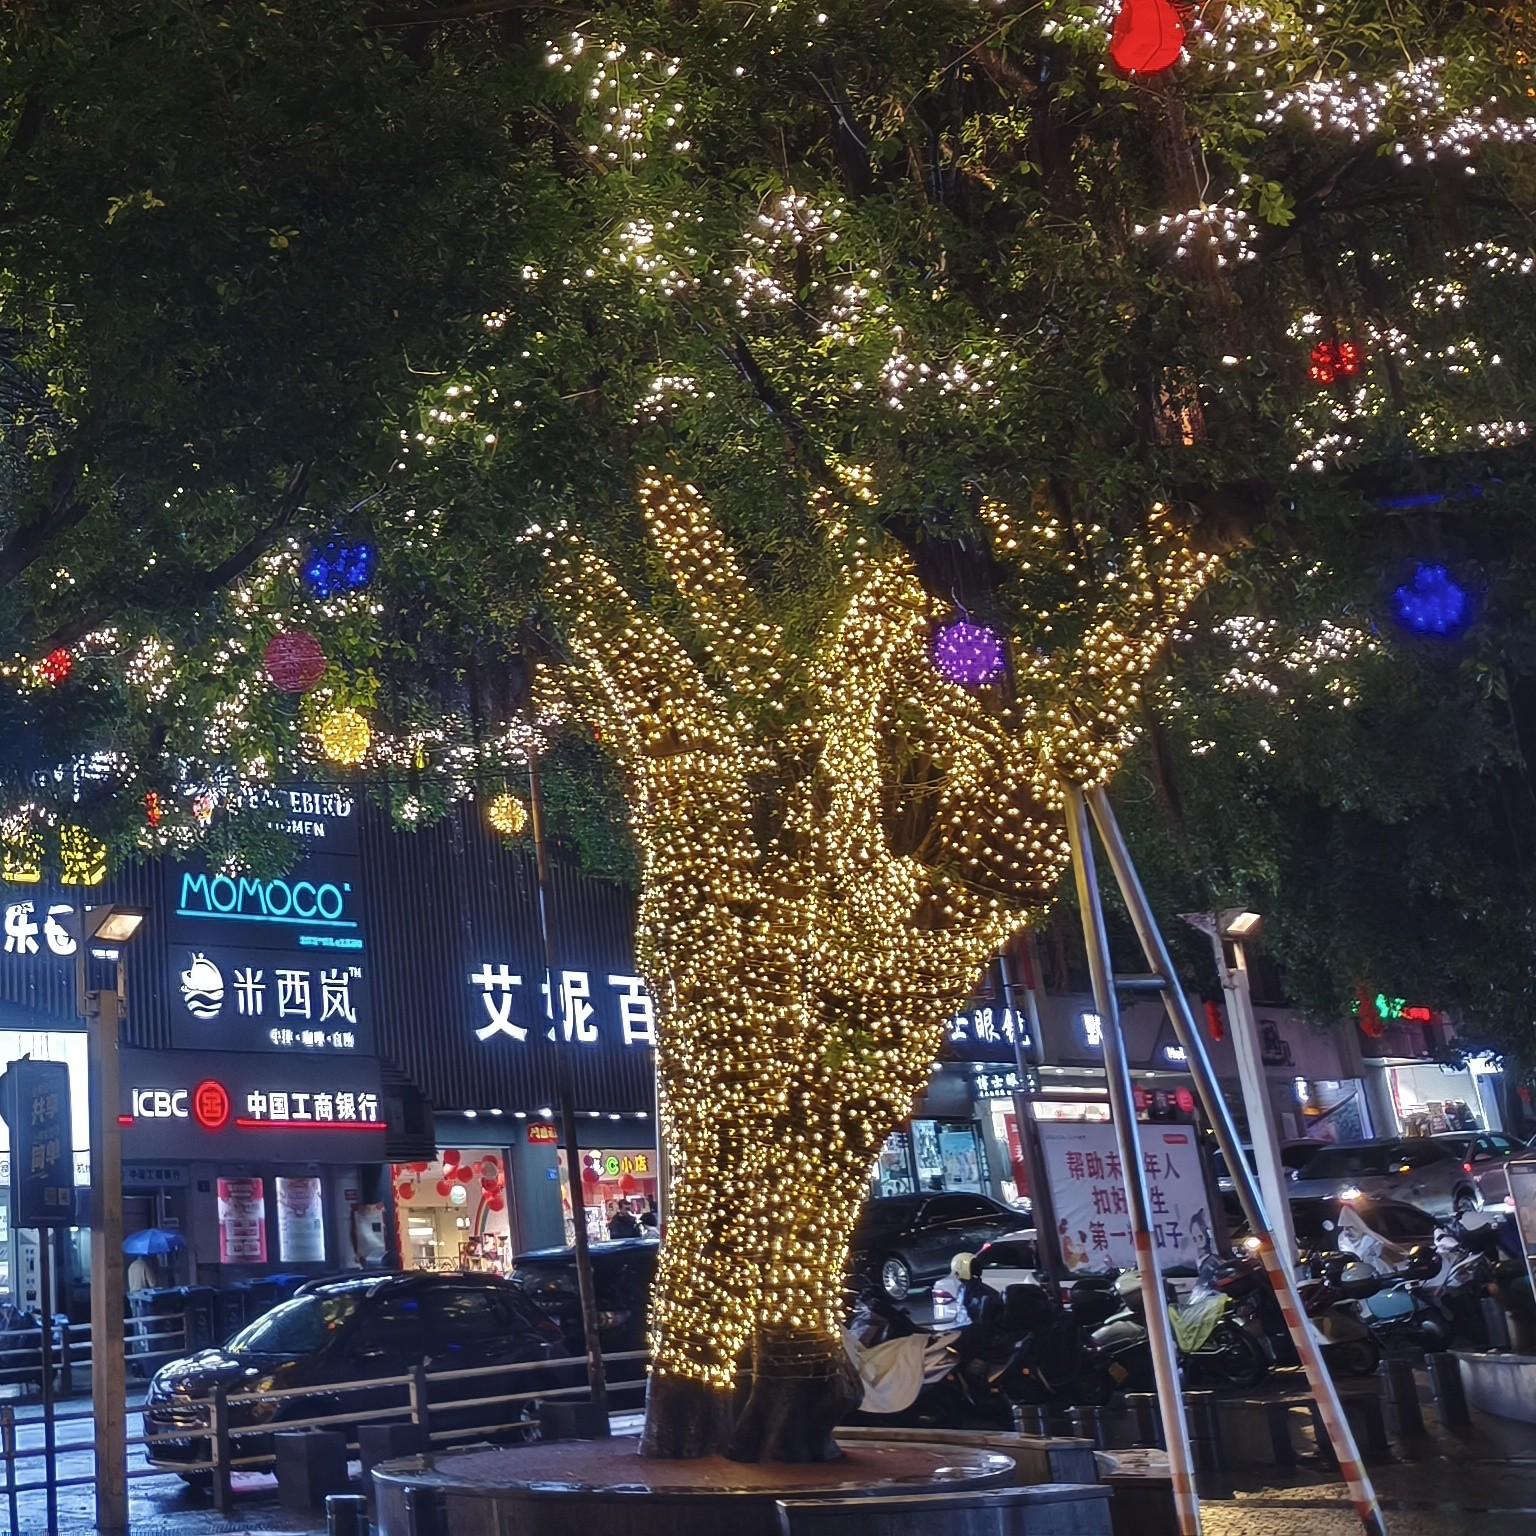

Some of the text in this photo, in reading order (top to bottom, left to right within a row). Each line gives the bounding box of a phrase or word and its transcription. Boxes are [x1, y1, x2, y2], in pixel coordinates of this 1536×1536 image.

[180, 872, 344, 920] MOMOCO
[233, 967, 357, 1024] 米西岚
[132, 1088, 189, 1118] ICBC
[247, 1090, 378, 1122] 中国工商银行
[1066, 1151, 1181, 1181] 帮助未年人
[1092, 1186, 1169, 1215] 扣好生
[1089, 1220, 1183, 1251] 第一扣子
